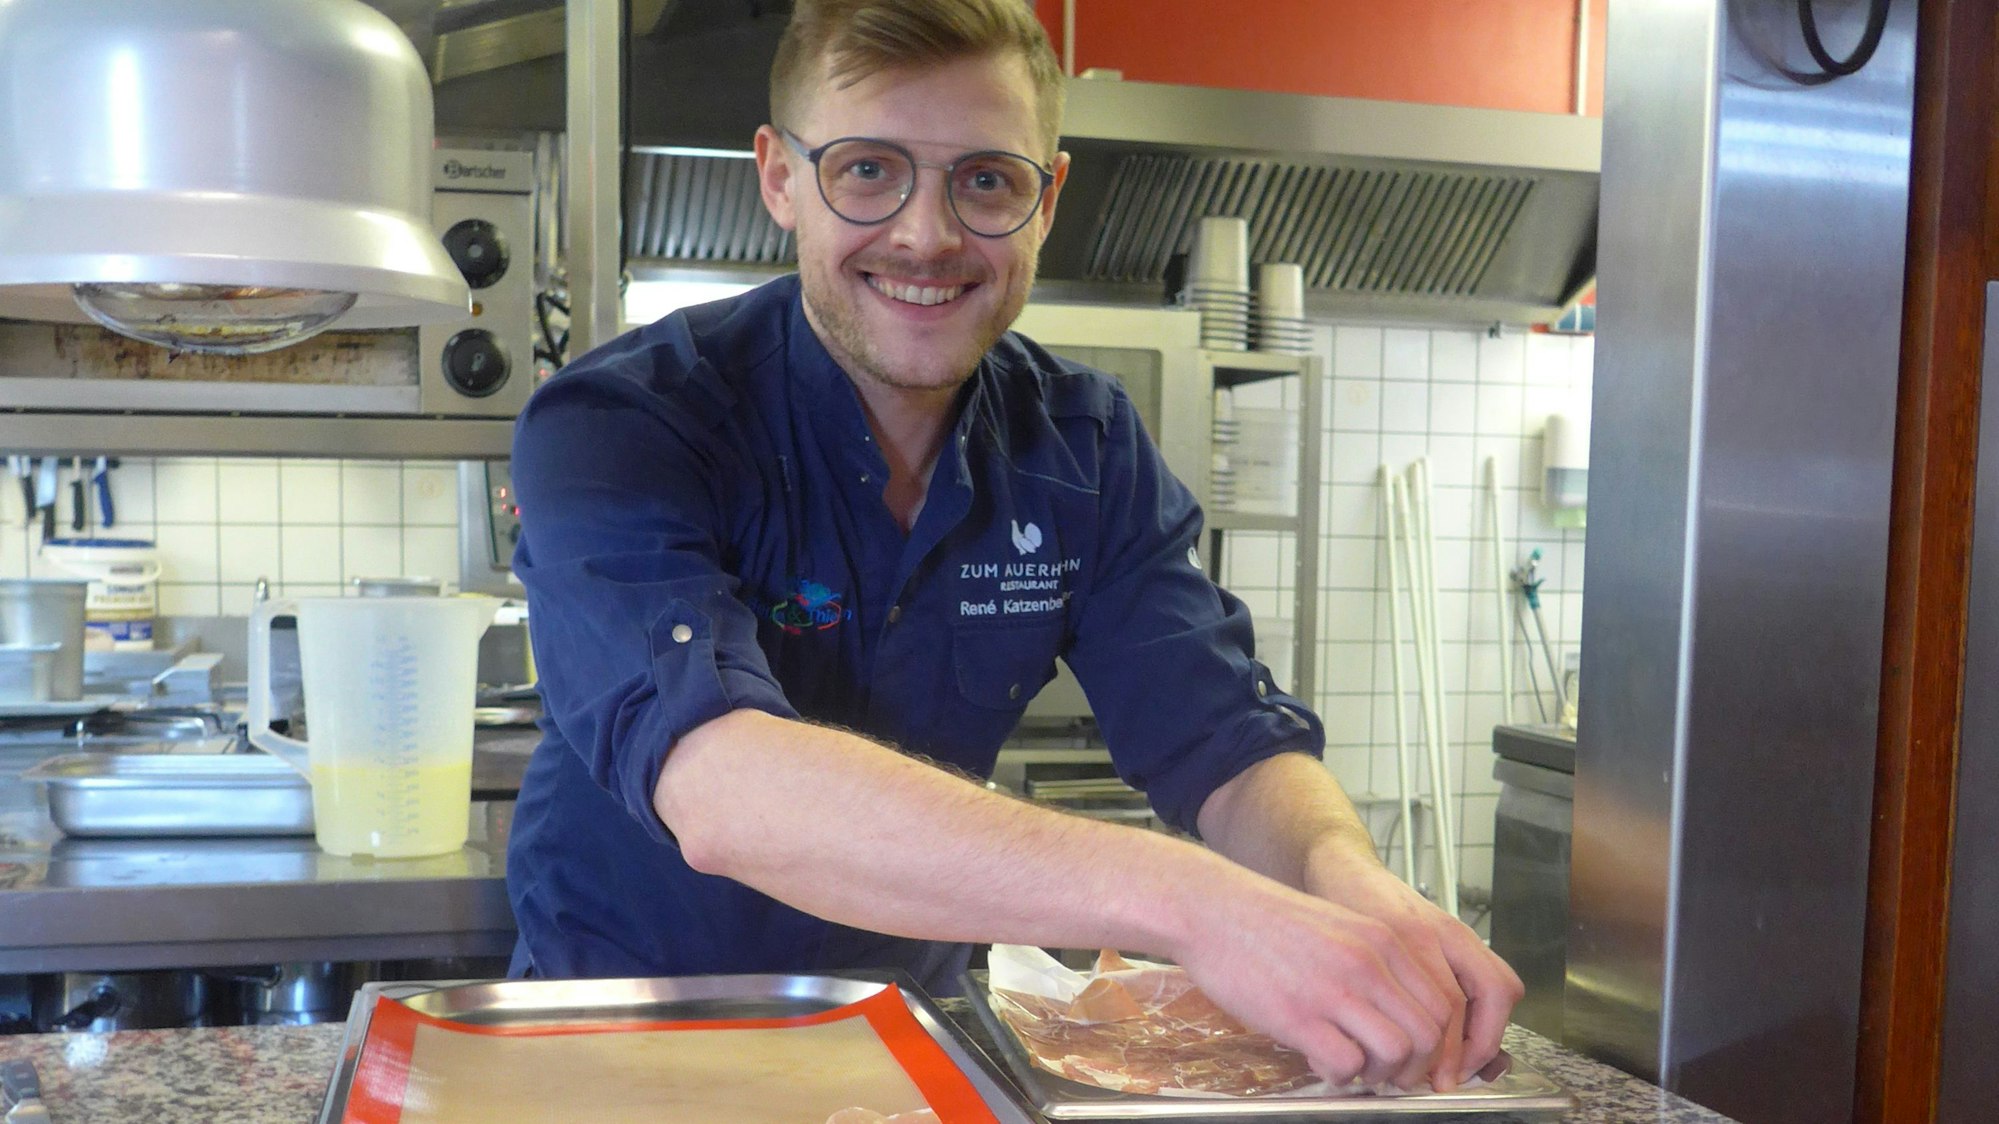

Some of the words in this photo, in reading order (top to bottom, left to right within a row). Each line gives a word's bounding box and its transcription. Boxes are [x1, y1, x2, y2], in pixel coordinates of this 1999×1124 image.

[961, 564, 998, 578] ZUM
[1000, 580, 1059, 591] RESTAURANT
[960, 600, 997, 615] René
